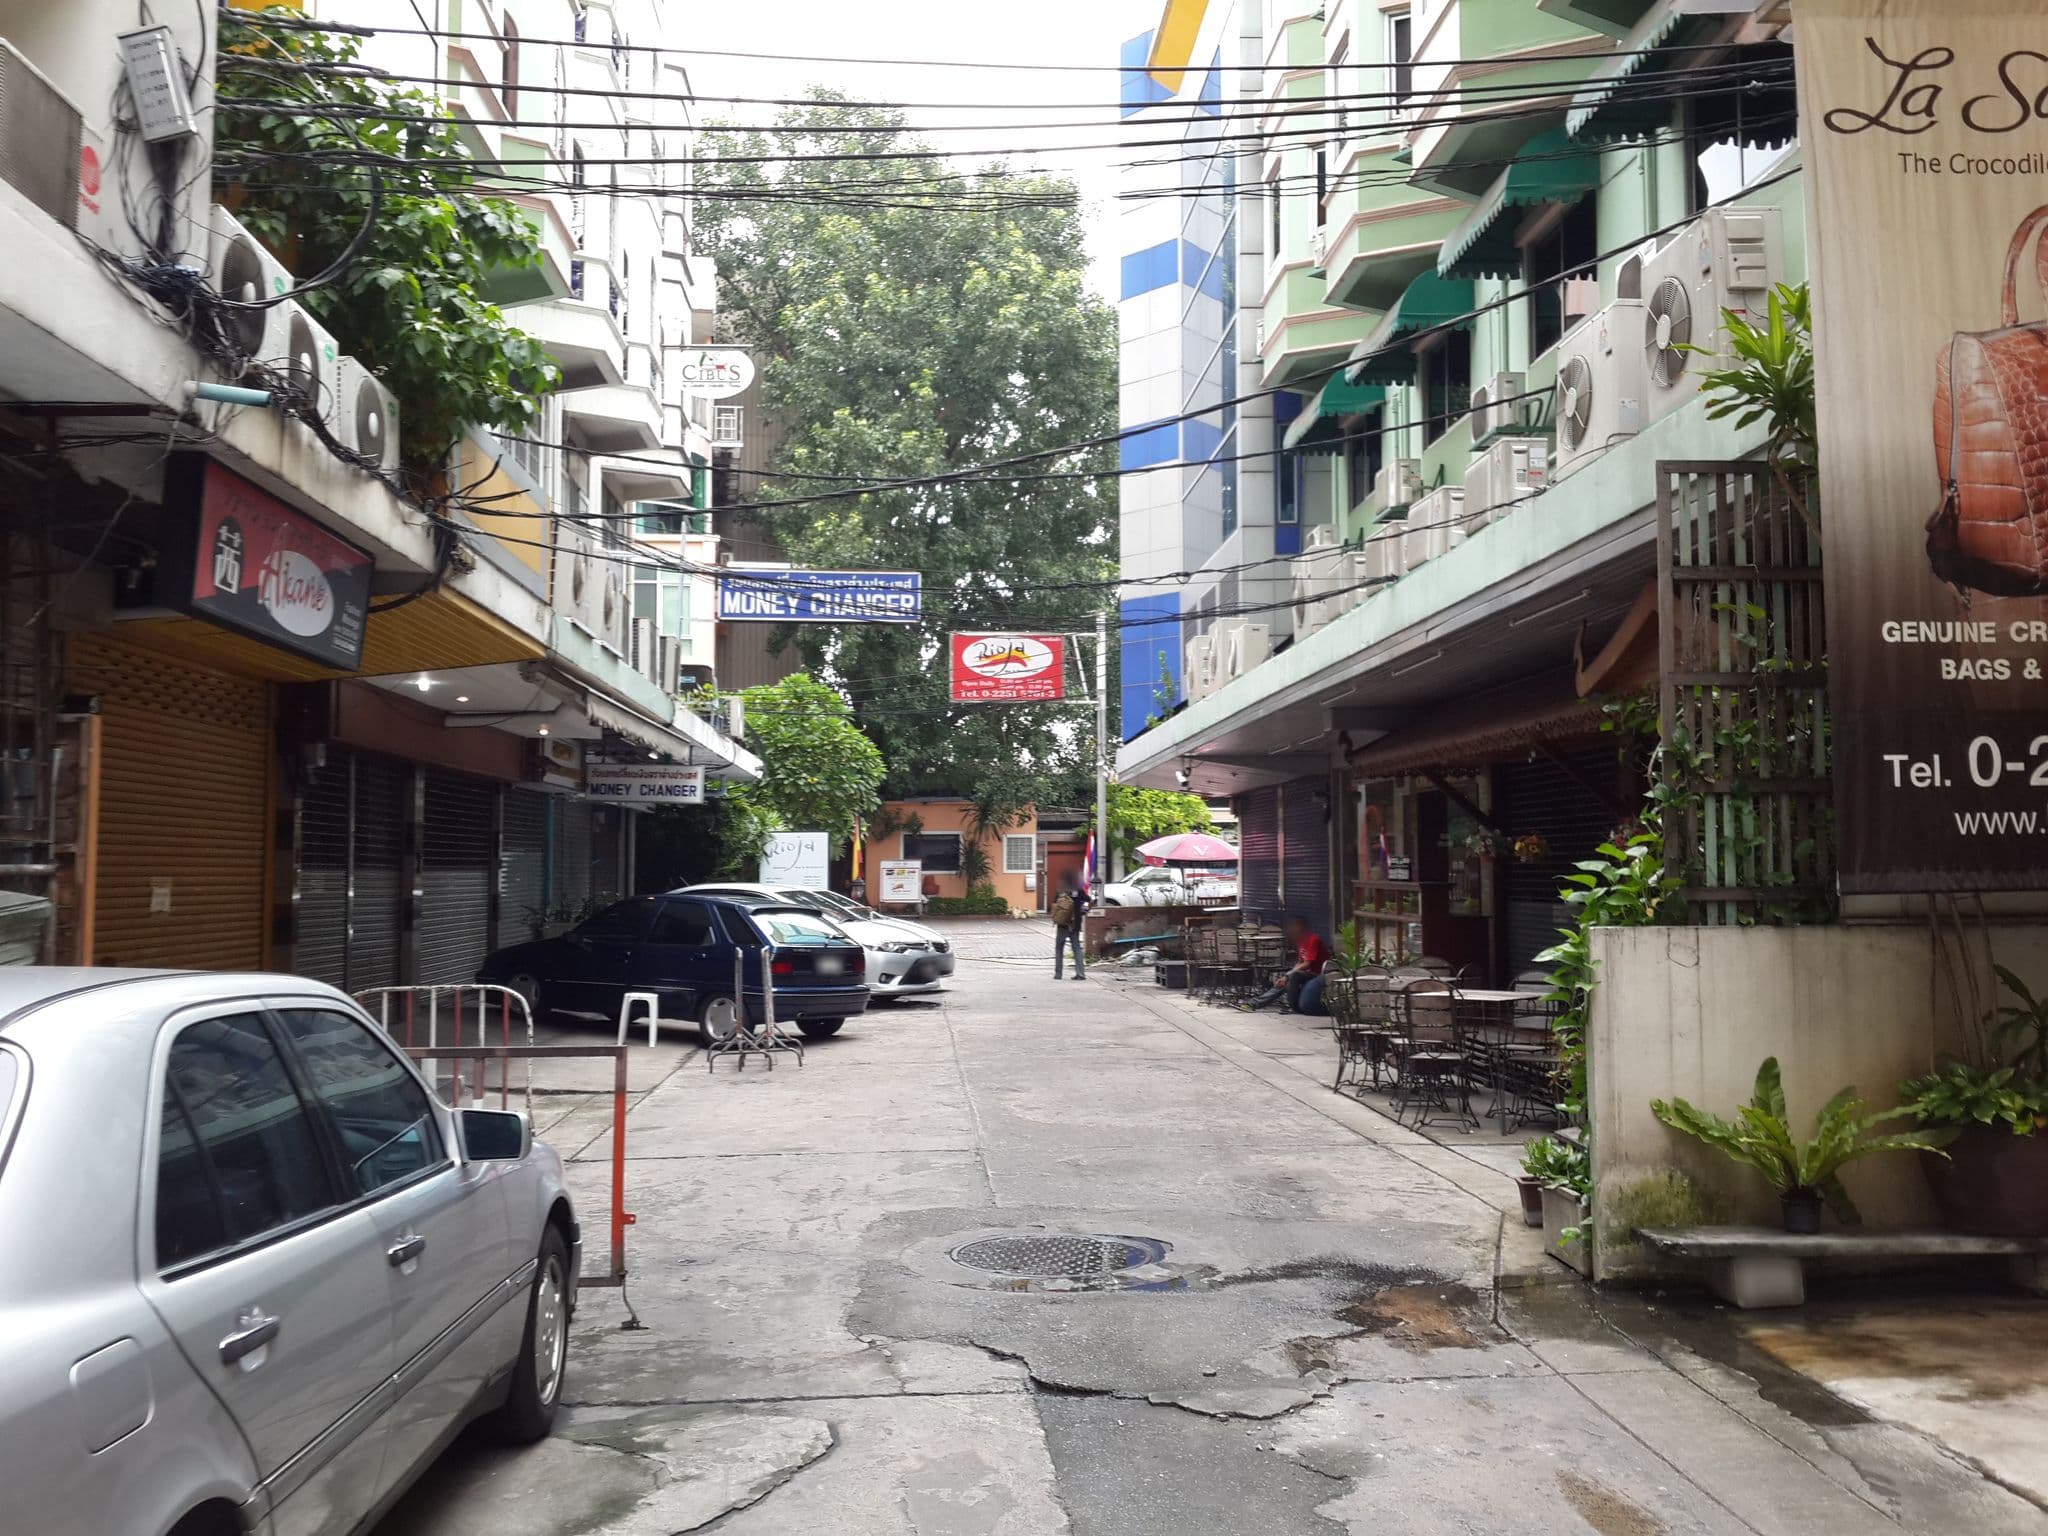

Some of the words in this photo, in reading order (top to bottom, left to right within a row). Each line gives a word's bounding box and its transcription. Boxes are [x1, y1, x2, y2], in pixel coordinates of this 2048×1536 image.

[1823, 36, 1954, 134] La
[1898, 152, 1941, 174] The
[1950, 152, 2048, 175] Crocodil
[723, 590, 801, 615] MONEY
[809, 592, 915, 617] CHANGER
[1881, 620, 1997, 643] GENUINE
[972, 638, 1027, 676] Rioja
[1940, 658, 2011, 681] BAGS
[2023, 658, 2042, 680] &
[1883, 753, 1952, 788] Tel.
[590, 783, 632, 796] MONEY
[640, 784, 697, 797] CHANGER
[1954, 803, 2048, 835] www.
